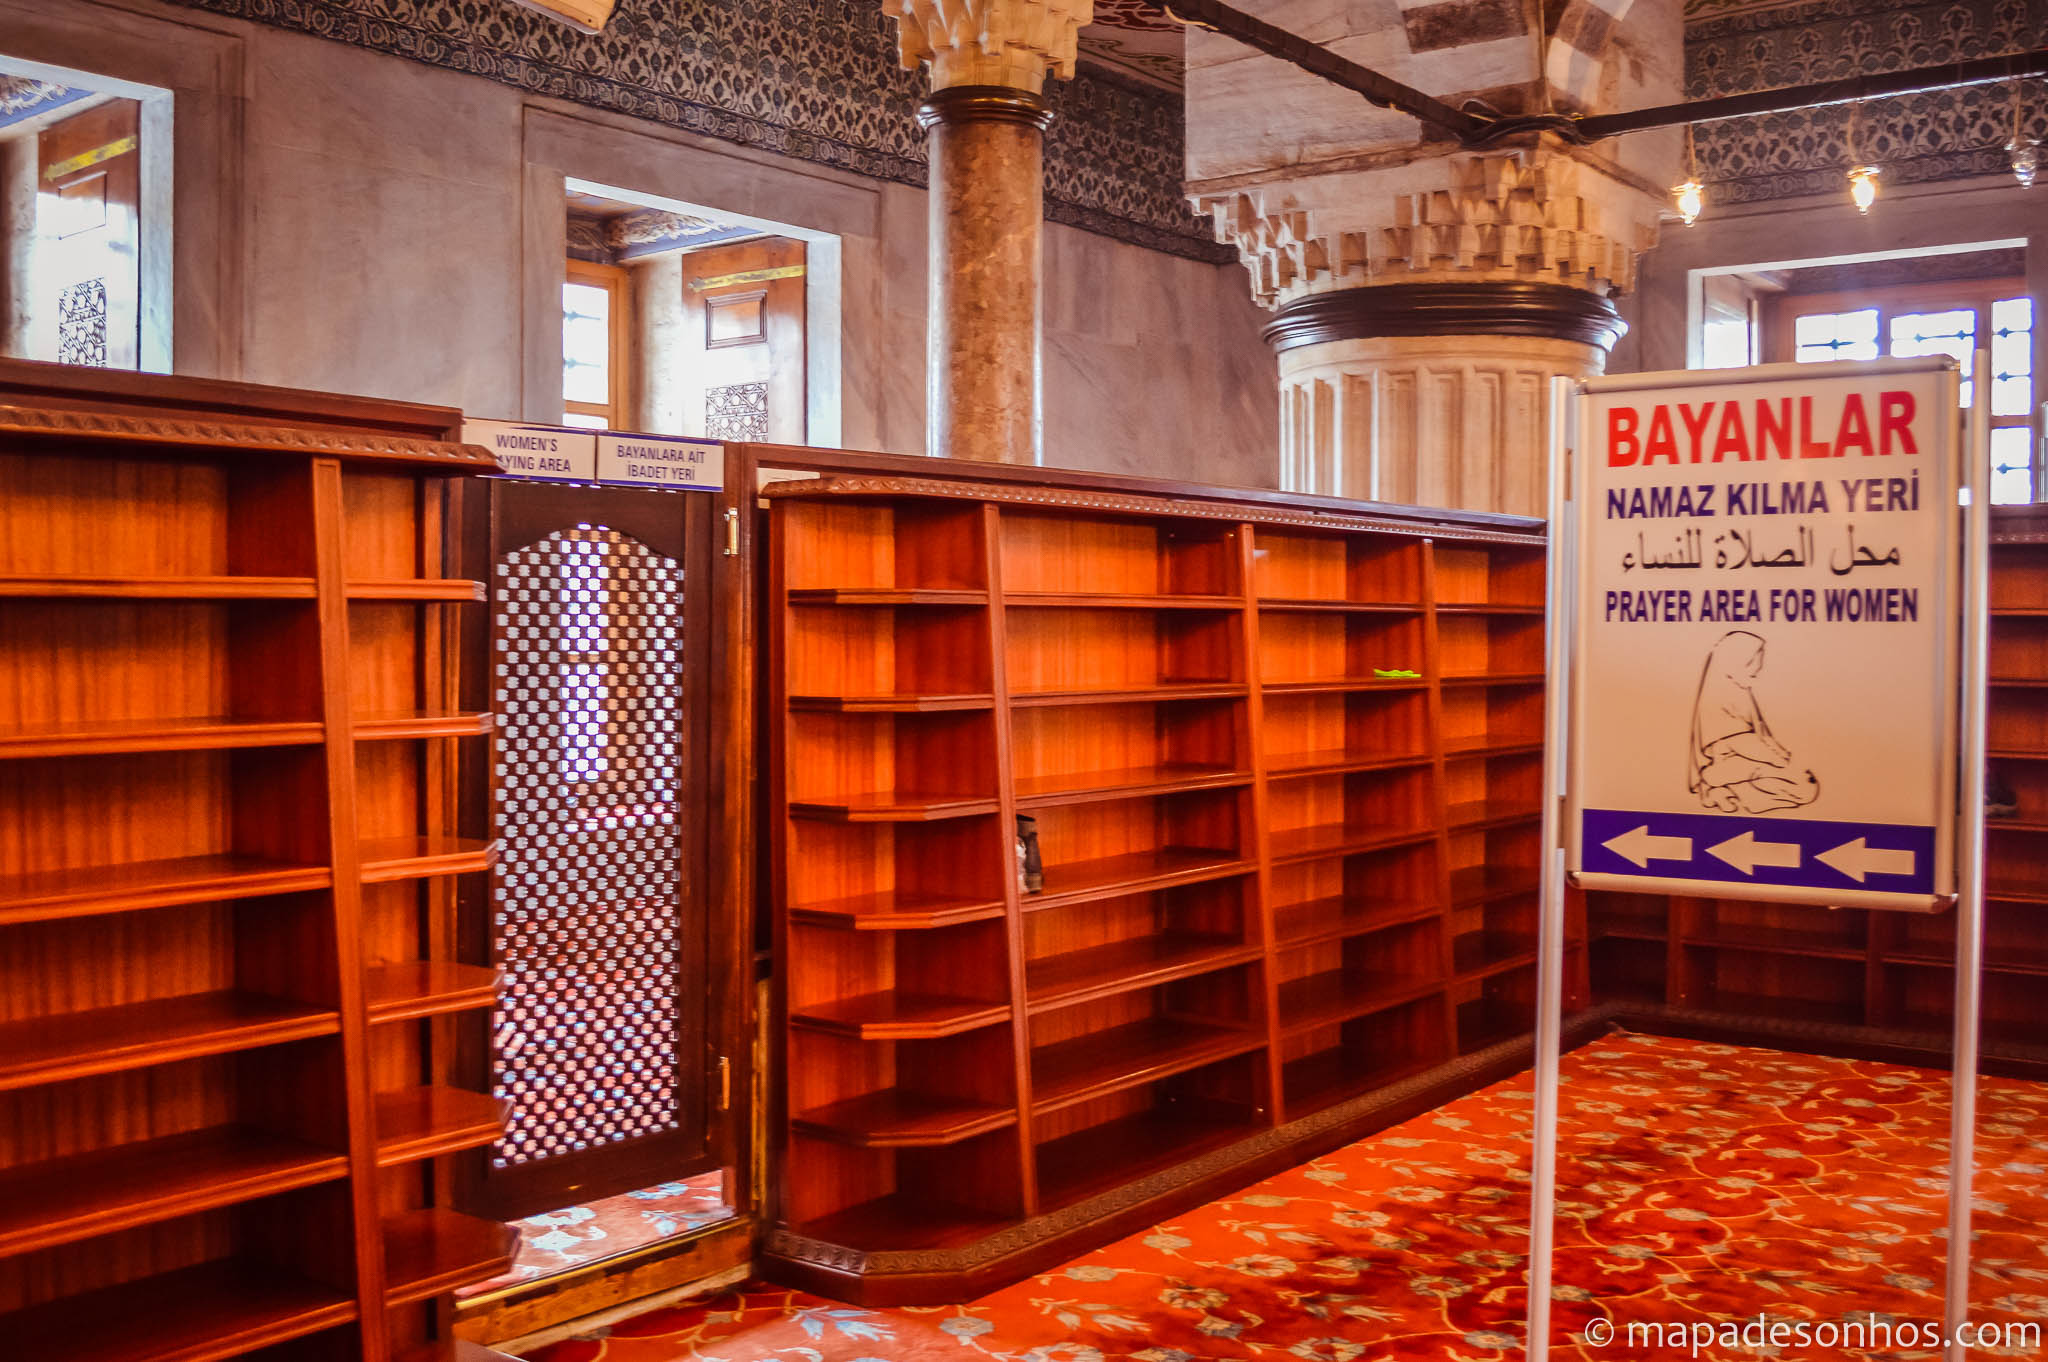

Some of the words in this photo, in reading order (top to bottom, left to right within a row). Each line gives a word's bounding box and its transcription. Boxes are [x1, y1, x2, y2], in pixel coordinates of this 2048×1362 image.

[496, 434, 558, 452] WOMEN'S
[1607, 390, 1919, 467] BAYANLAR
[539, 457, 571, 472] AREA
[617, 445, 684, 462] BAYANLARA
[627, 460, 668, 479] İBADET
[1607, 484, 1715, 520] NAMAZ
[1727, 480, 1829, 516] KILMA
[1841, 469, 1919, 512] YERİ
[1622, 529, 1702, 573] للنساء
[1714, 525, 1814, 570] الصلاة
[1830, 525, 1900, 576] محل
[1605, 590, 1693, 623] PRAYER
[1700, 590, 1761, 623] AREA
[1770, 588, 1816, 622] FOR
[1824, 588, 1918, 622] WOMEN
